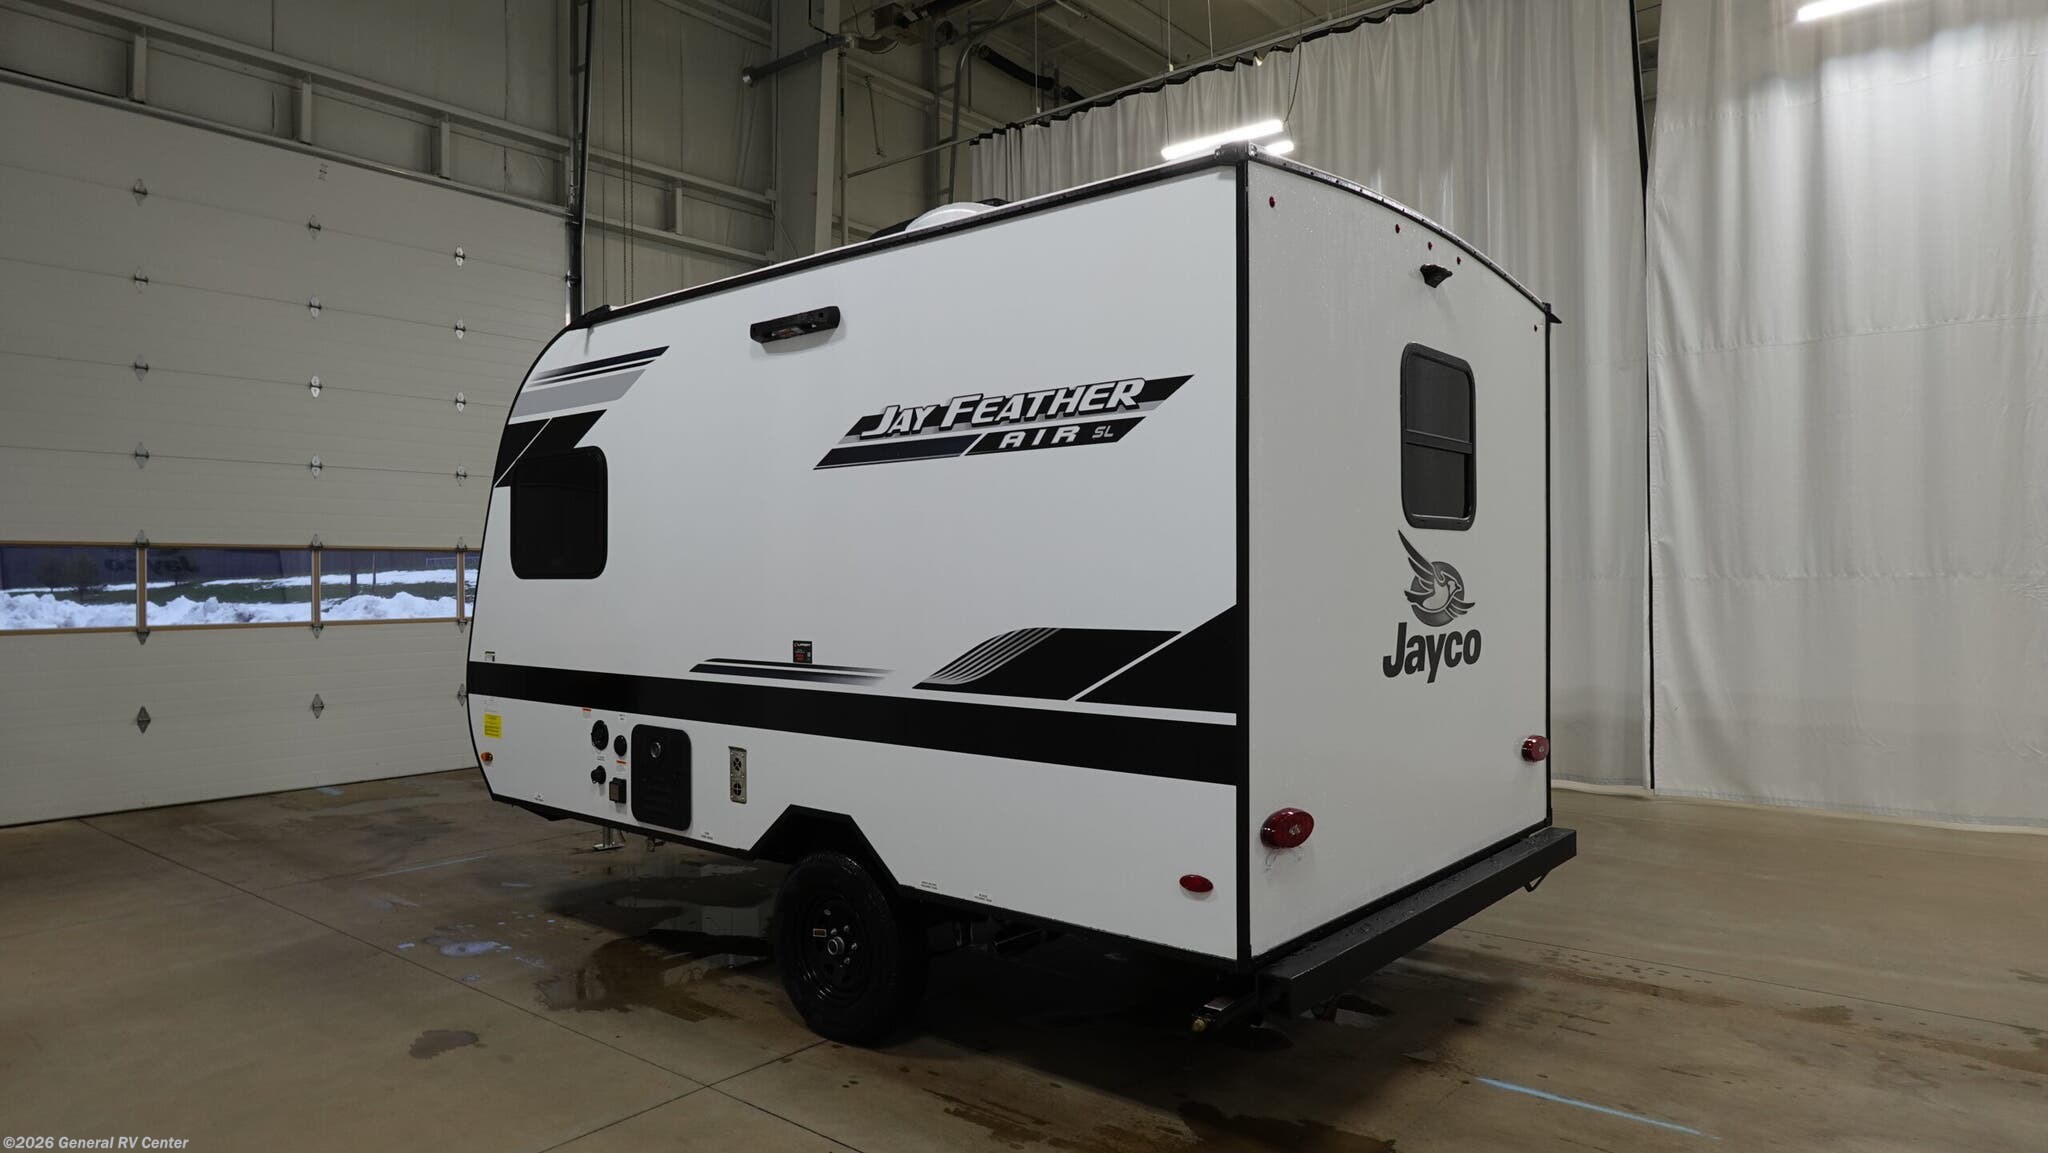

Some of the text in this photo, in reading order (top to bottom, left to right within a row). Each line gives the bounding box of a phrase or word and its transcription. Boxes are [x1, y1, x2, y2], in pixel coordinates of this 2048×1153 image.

[860, 377, 1145, 439] JAY FEATHER
[999, 425, 1114, 449] AIR SL
[1382, 621, 1482, 684] Jayco
